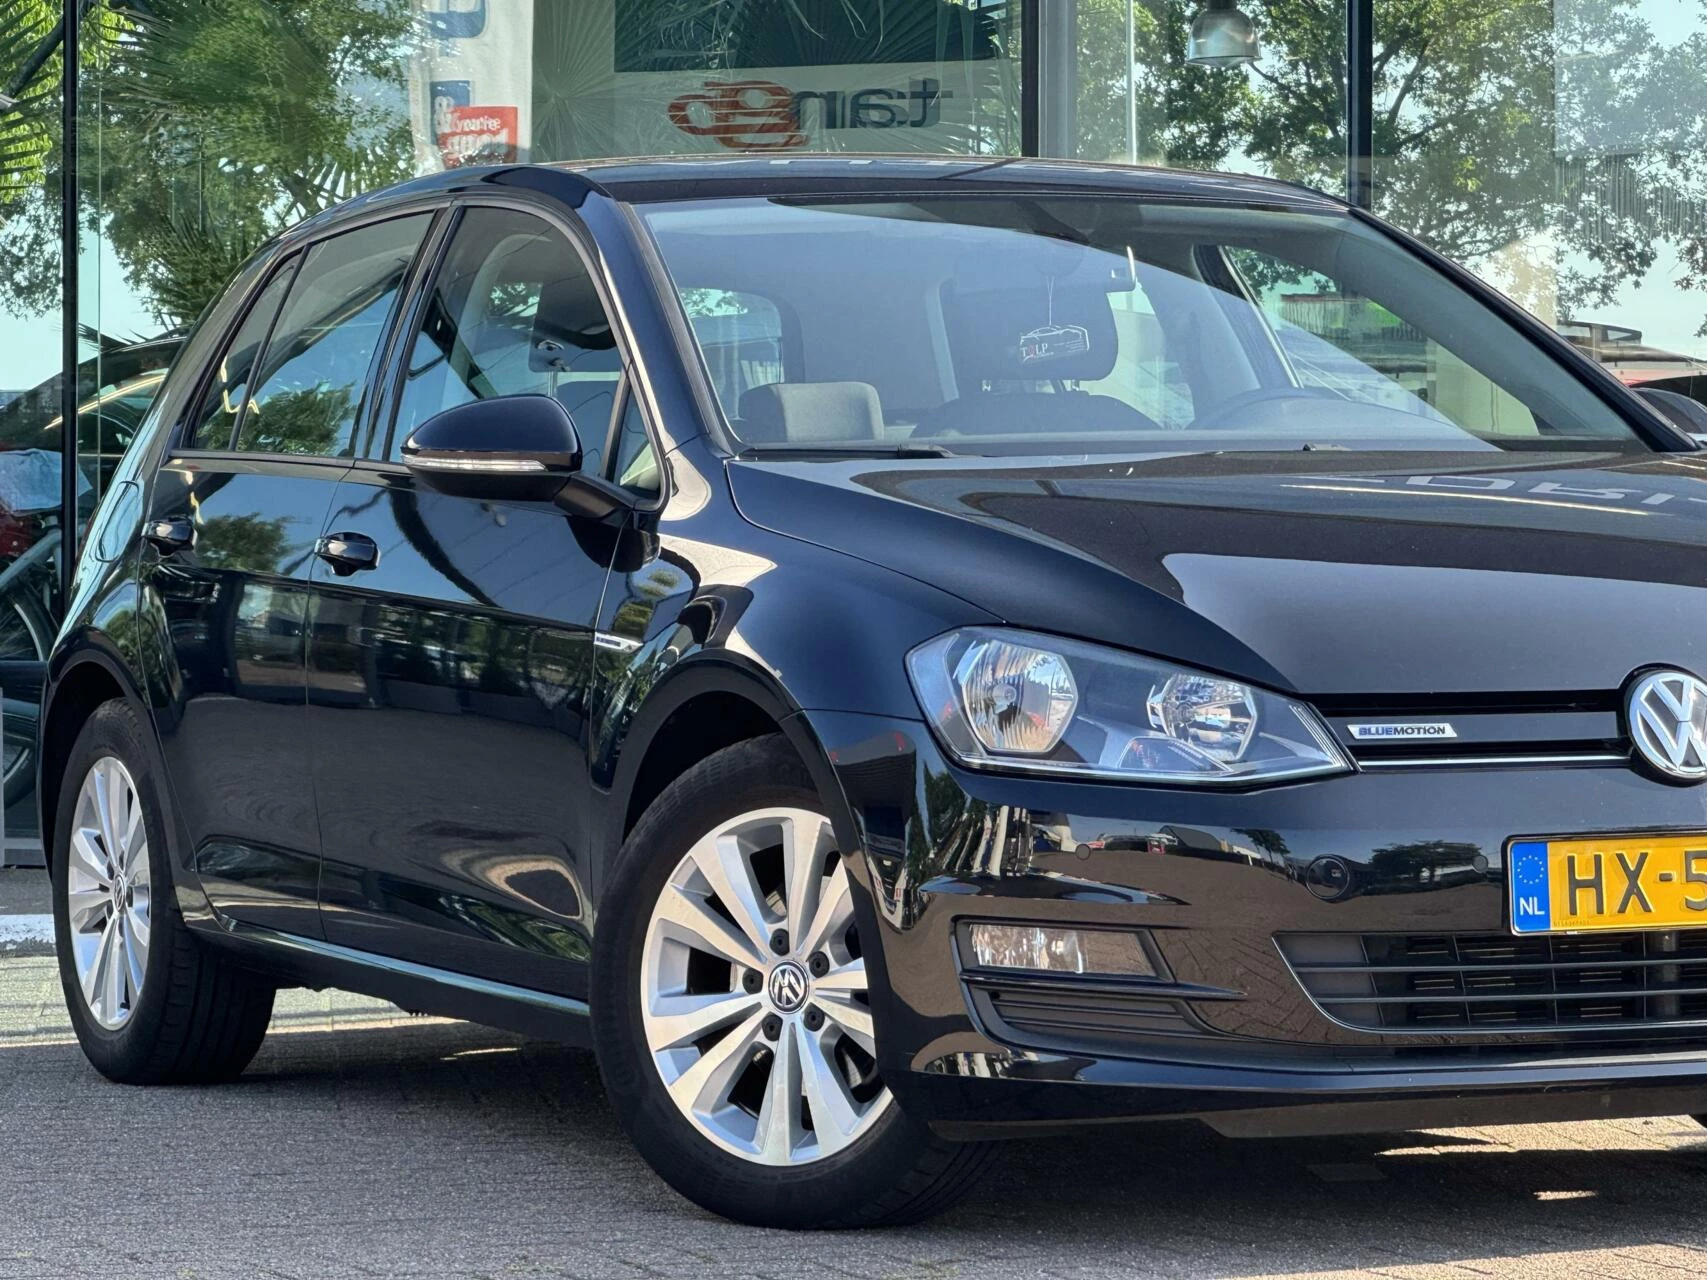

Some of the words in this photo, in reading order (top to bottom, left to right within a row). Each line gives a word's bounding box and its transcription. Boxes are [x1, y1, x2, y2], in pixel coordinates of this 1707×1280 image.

[1358, 726, 1446, 736] BLUEMOTION
[1567, 850, 1707, 916] HX-5
[1519, 896, 1545, 916] NL
